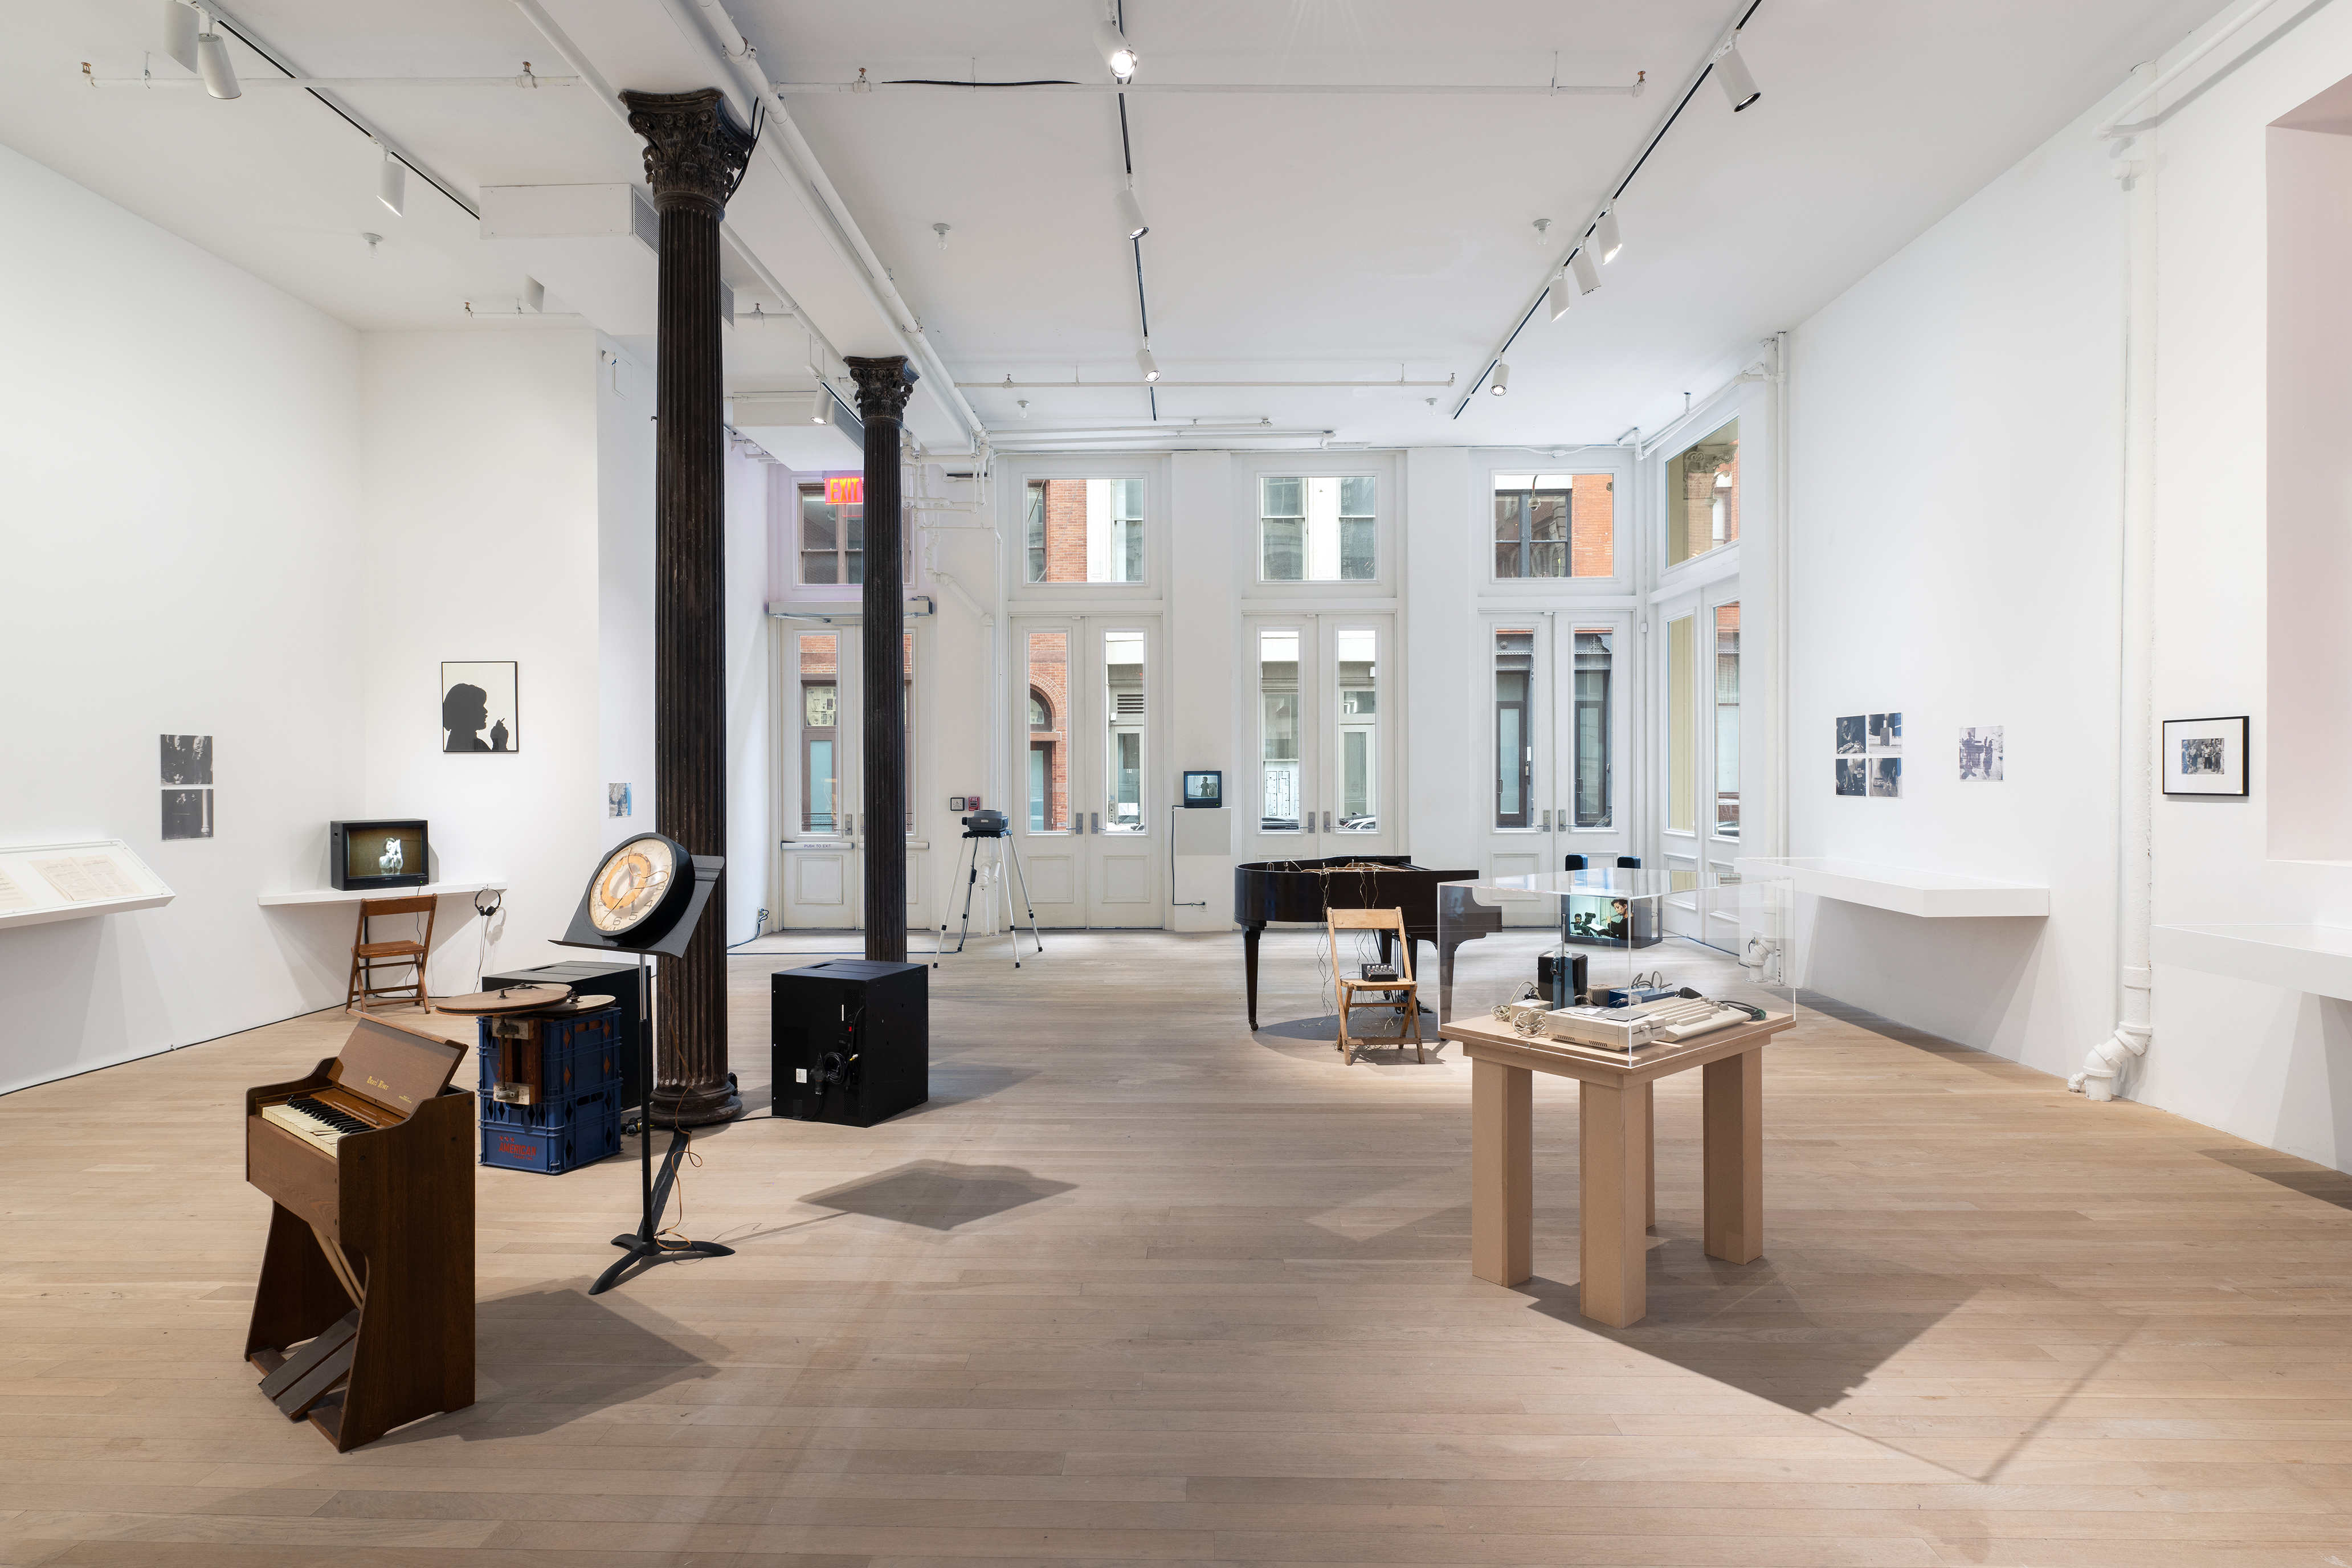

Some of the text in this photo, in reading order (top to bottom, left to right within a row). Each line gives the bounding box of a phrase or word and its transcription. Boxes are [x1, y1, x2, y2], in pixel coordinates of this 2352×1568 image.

[830, 478, 859, 503] EXIT
[642, 846, 654, 855] 12
[644, 899, 653, 908] 4
[628, 912, 639, 921] 5
[612, 917, 622, 926] 6
[366, 1076, 389, 1091] Pearl River
[499, 1142, 537, 1156] AMERICAN
